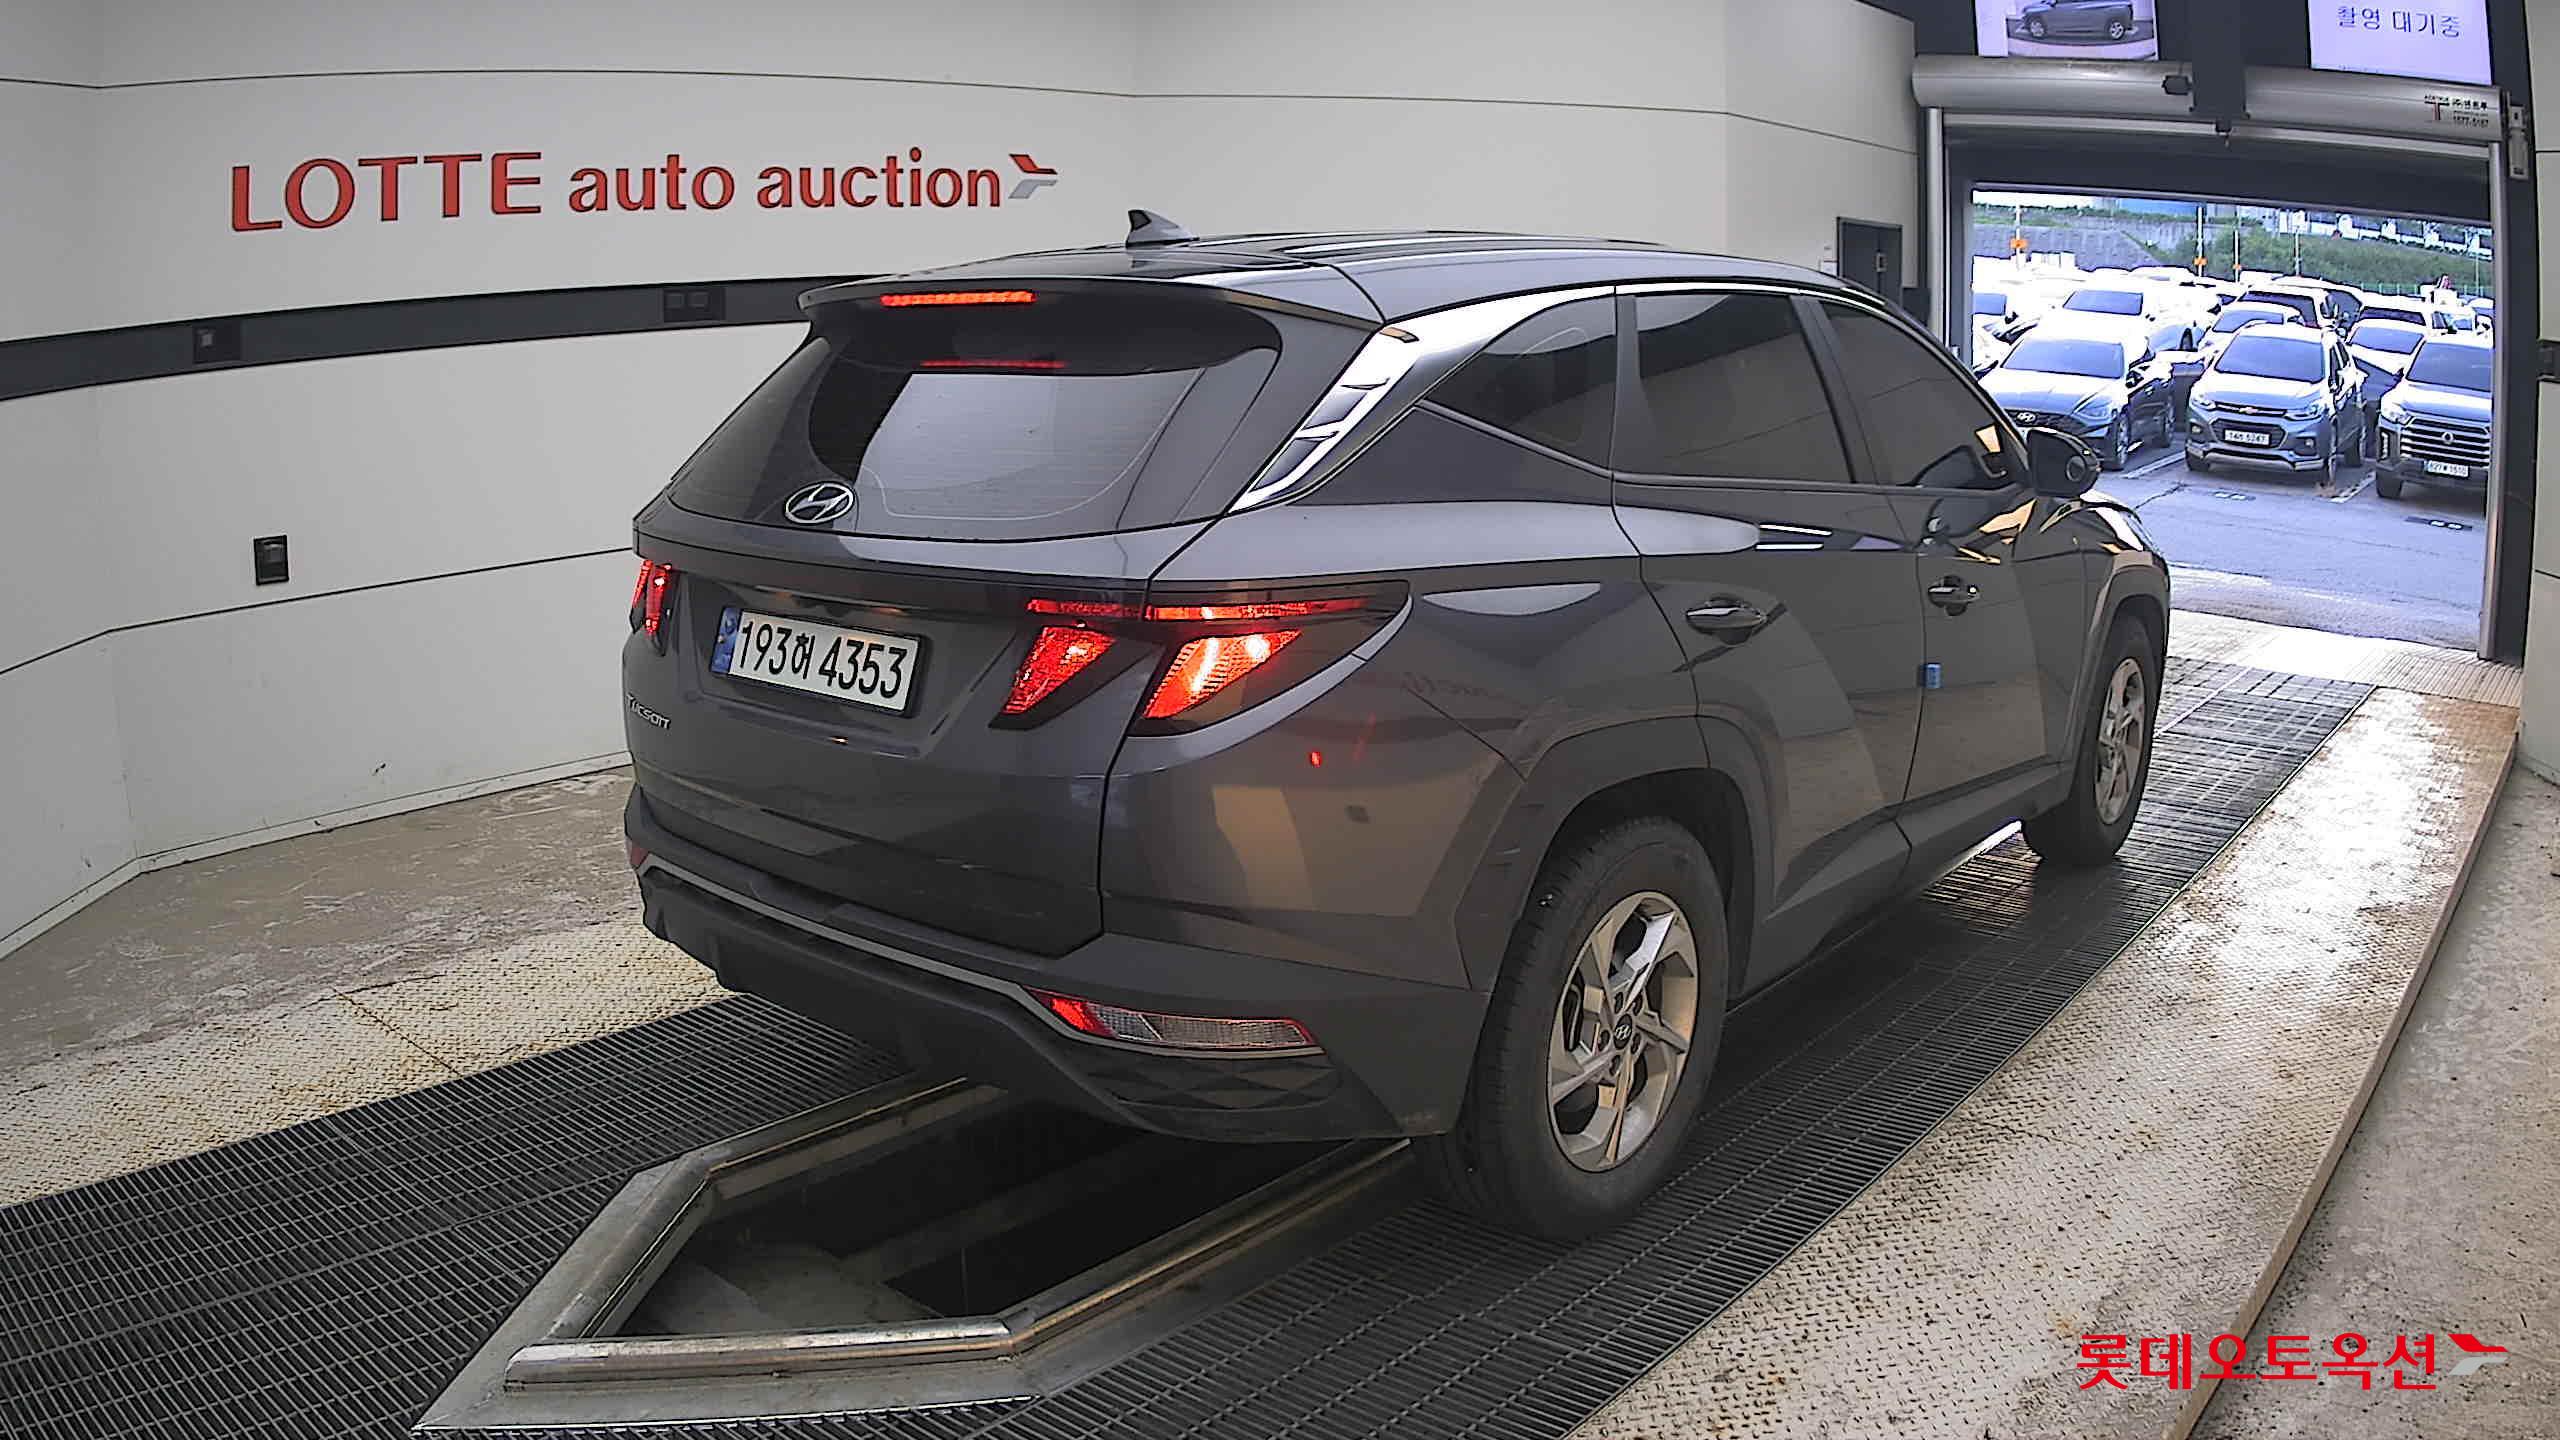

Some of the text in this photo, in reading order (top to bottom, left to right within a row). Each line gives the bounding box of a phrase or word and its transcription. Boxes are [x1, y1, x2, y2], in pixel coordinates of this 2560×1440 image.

[2391, 11, 2461, 38] 대기중
[231, 148, 1000, 231] LOTTE auto auction
[740, 621, 908, 699] 193허 4353
